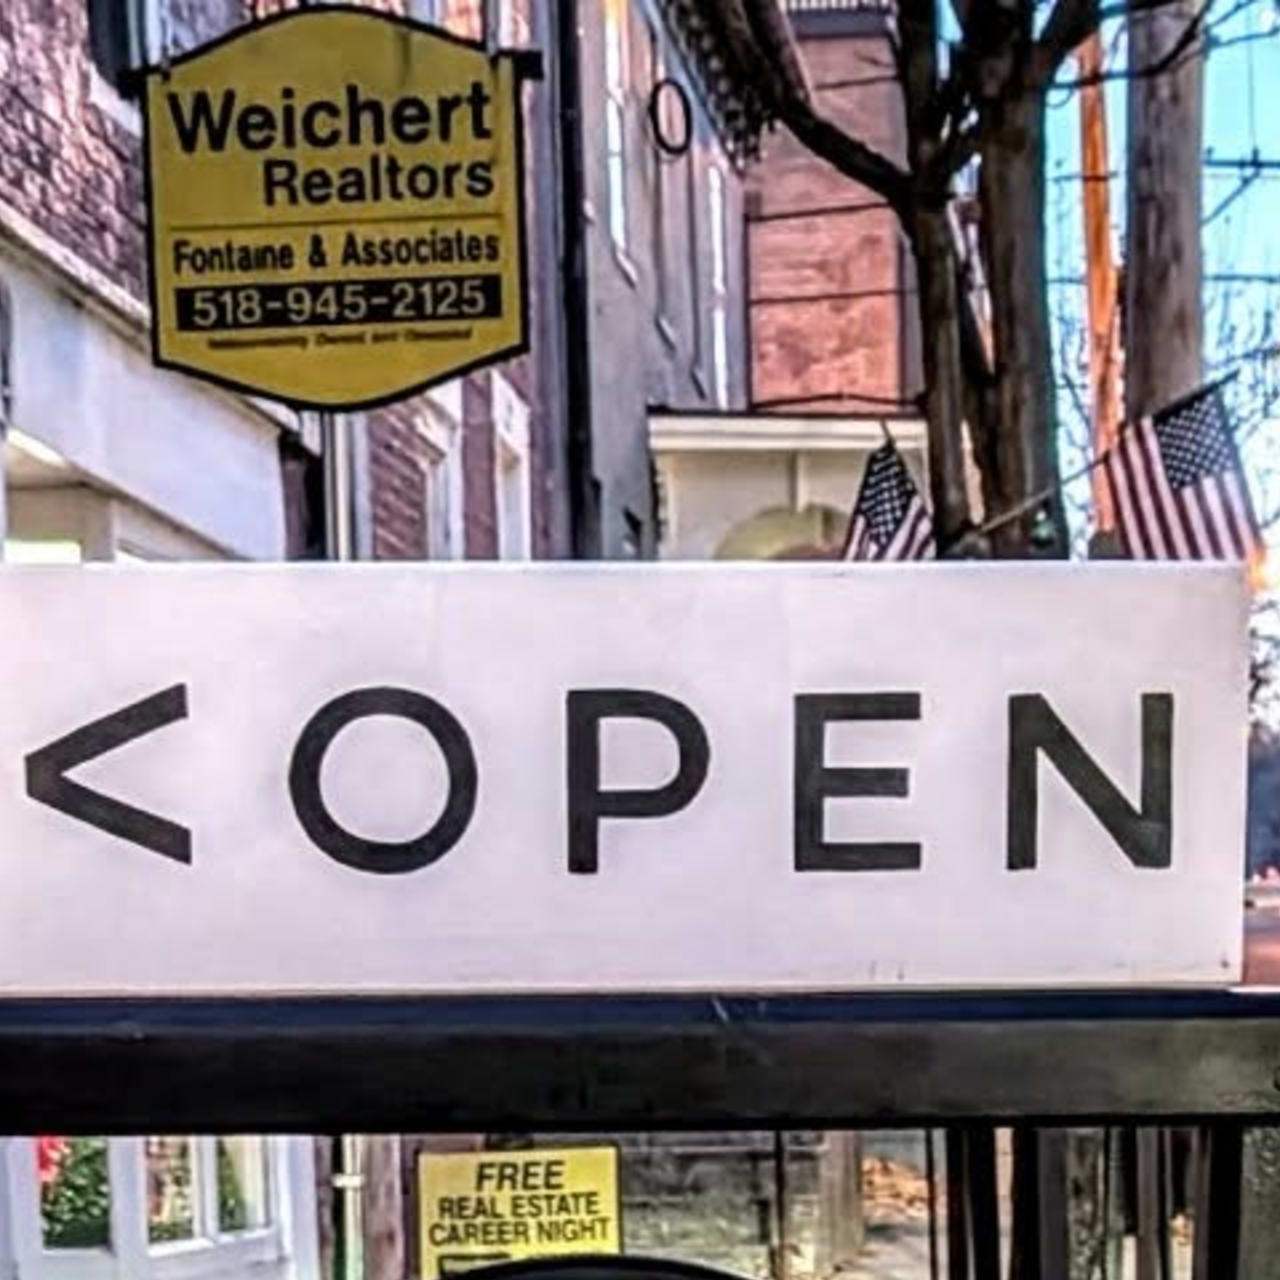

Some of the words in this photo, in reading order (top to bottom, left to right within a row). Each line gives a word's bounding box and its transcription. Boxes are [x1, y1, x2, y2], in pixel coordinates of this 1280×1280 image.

[168, 82, 492, 153] Weichert
[263, 154, 494, 206] Realtors
[173, 240, 294, 274] Fontaine
[308, 235, 326, 267] &
[341, 228, 500, 266] Associates
[192, 278, 486, 326] 518-945-2125
[475, 1160, 565, 1192] FREE
[439, 1197, 504, 1219] REAL
[511, 1192, 599, 1217] ESTATE
[429, 1221, 529, 1246] CAREER
[537, 1217, 611, 1242] NIGHT
